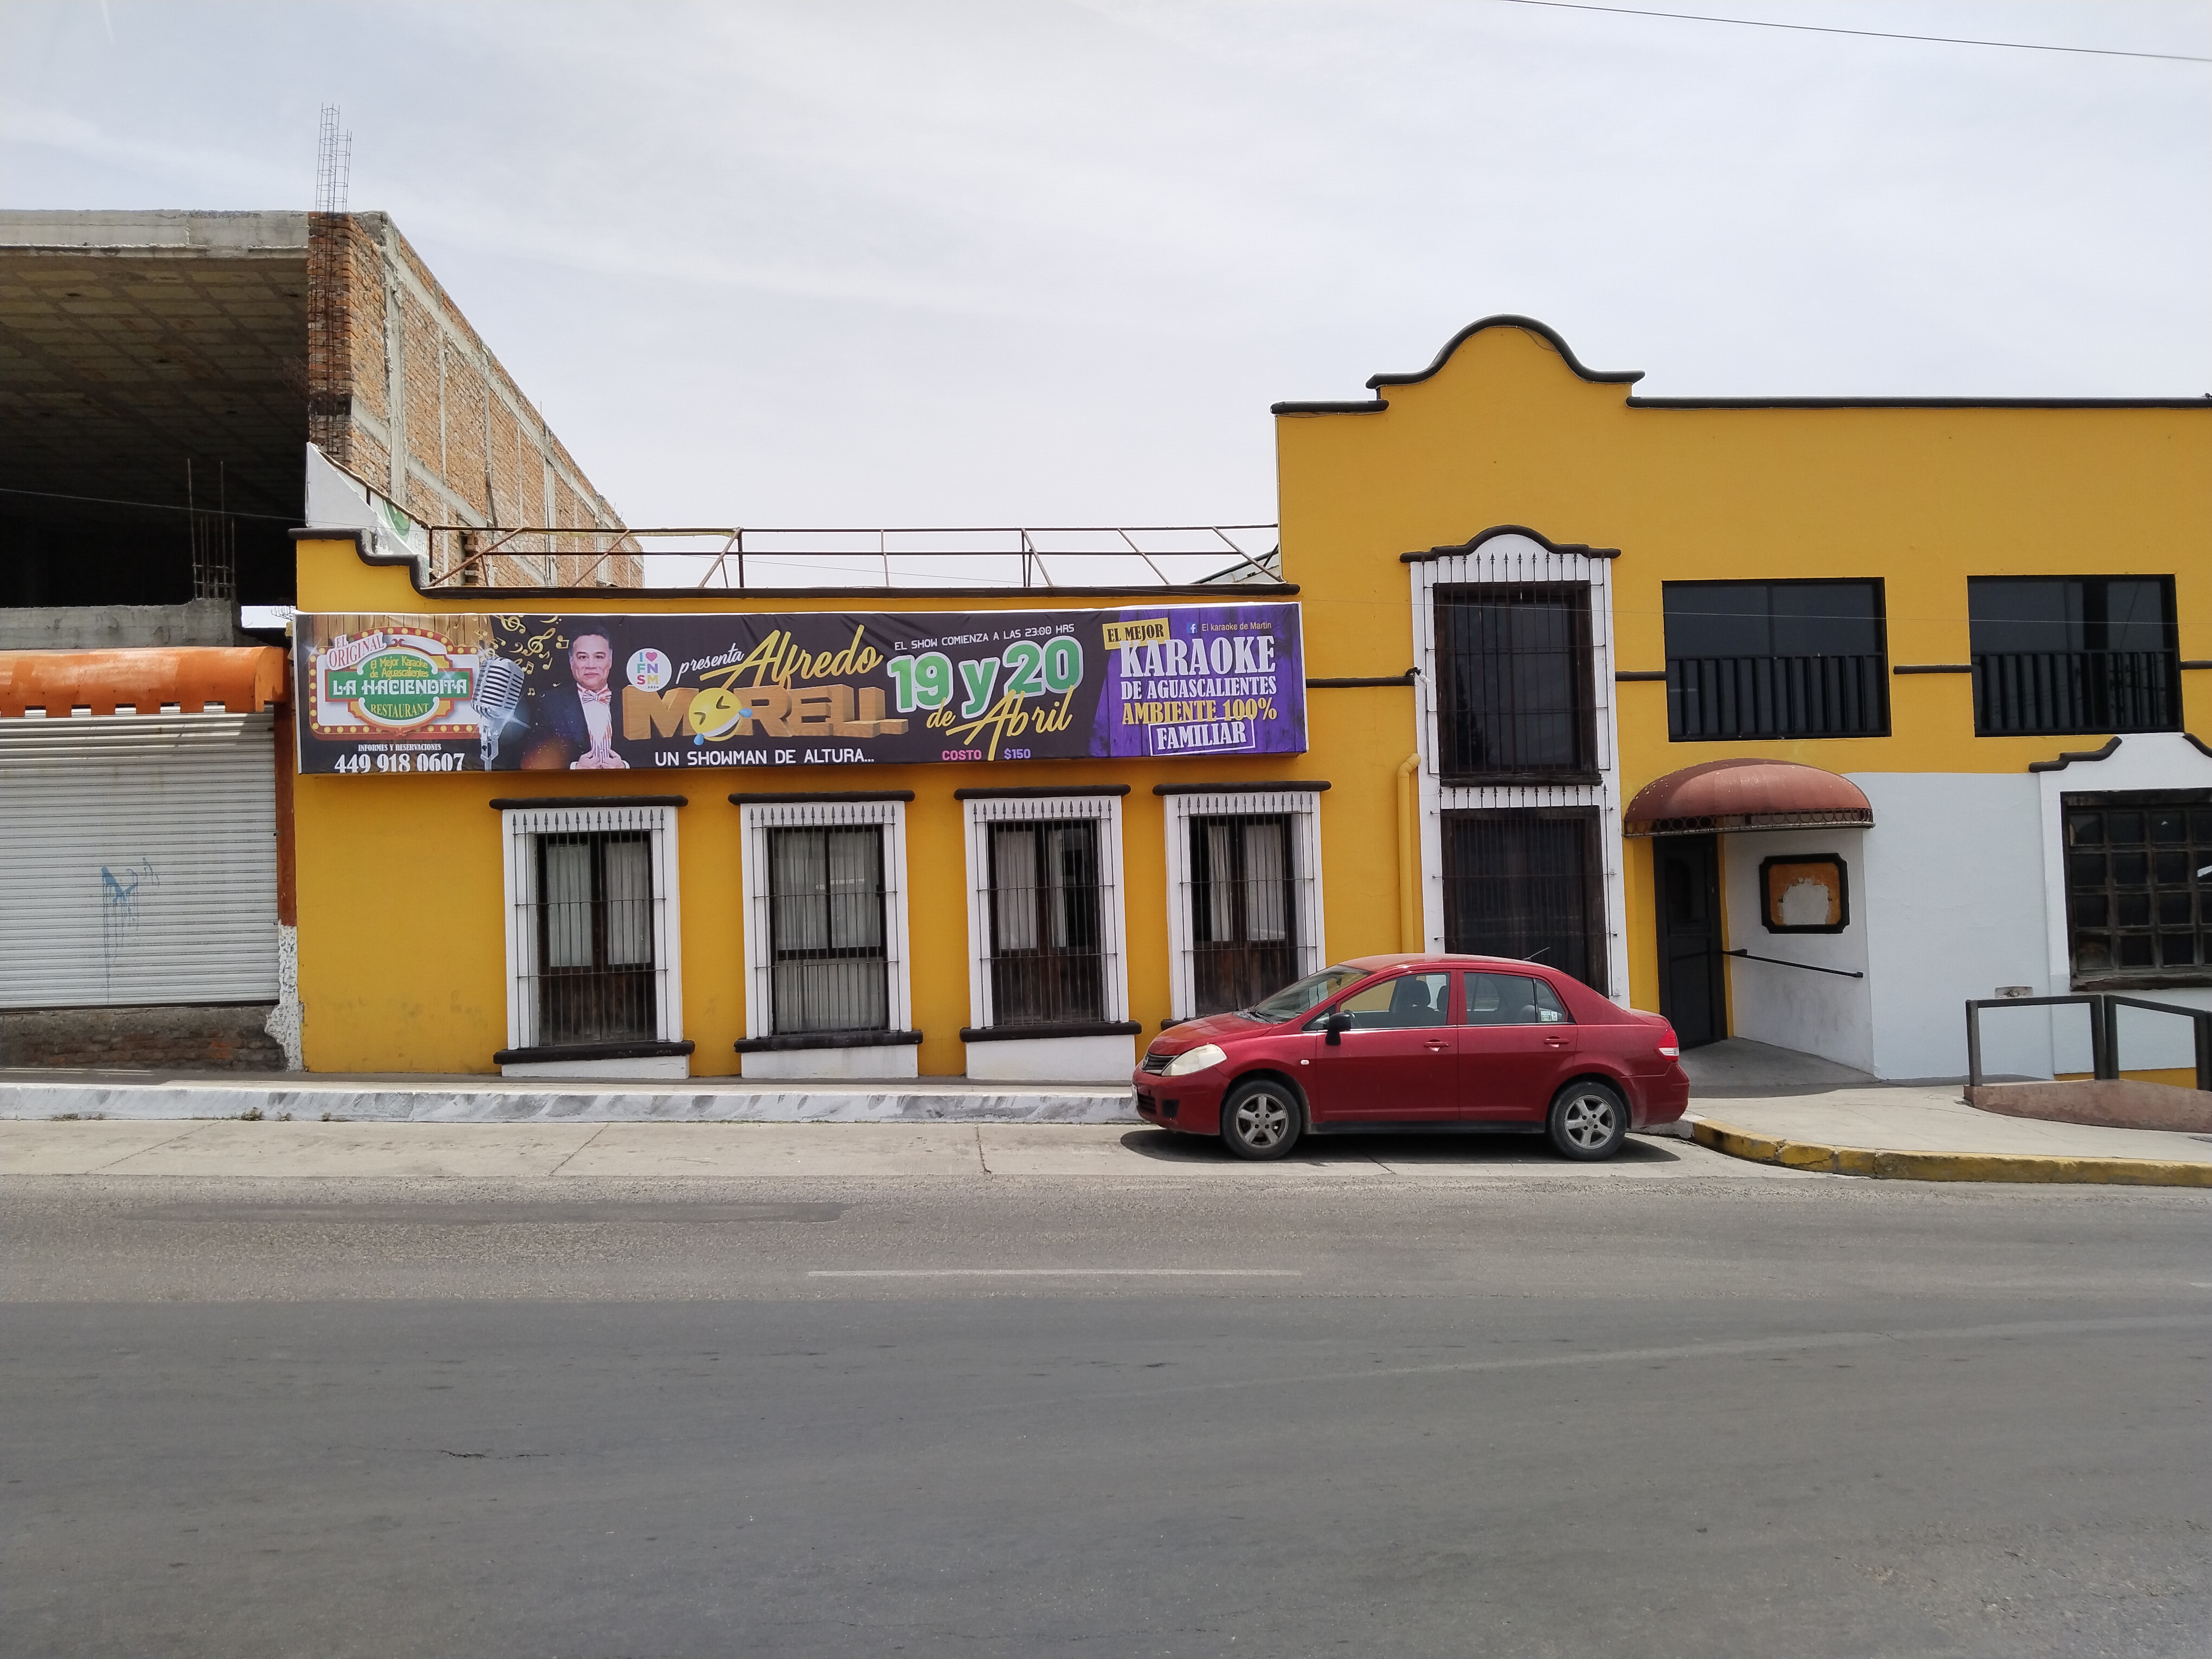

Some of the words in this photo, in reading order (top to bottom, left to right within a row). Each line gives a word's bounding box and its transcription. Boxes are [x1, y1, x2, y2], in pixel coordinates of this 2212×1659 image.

[895, 641, 907, 651] EL
[911, 639, 938, 649] SHOW
[942, 633, 989, 646] COMIENZA
[993, 632, 999, 641] A
[1004, 629, 1021, 640] LAS
[1025, 626, 1051, 637] 23:00
[1056, 623, 1075, 634] HRS
[1107, 628, 1122, 642] EL
[1125, 624, 1164, 642] MEJOR
[1211, 622, 1238, 631] karaoke
[1239, 622, 1249, 630] de
[329, 635, 384, 668] ORIGINAL
[336, 636, 348, 648] EL
[370, 660, 377, 669] El
[380, 656, 399, 670] Mejor
[402, 655, 428, 668] Karaoke
[676, 642, 745, 684] presenta
[699, 624, 884, 690] Alfredo
[1119, 635, 1276, 677] KARAOKE
[370, 669, 378, 678] de
[381, 667, 429, 680] Aguascalientes
[887, 652, 953, 712] 19
[959, 657, 1000, 719] y
[1002, 636, 1084, 699] 20
[333, 680, 357, 695] LA
[361, 679, 467, 696] HACIENDITA
[1121, 681, 1142, 699] DE
[1147, 676, 1277, 699] AGUASCALIENTES
[371, 703, 429, 718] RESTAURANT
[1122, 699, 1217, 724] AMBIENTE
[1223, 697, 1277, 721] 100%
[926, 697, 956, 729] de
[946, 685, 1075, 761] Abril
[1156, 721, 1246, 750] FAMILIAR
[334, 754, 371, 773] 449
[377, 753, 411, 773] 918
[416, 753, 465, 771] 0607
[655, 751, 679, 766] UN
[687, 750, 767, 766] SHOWMAN
[775, 749, 796, 764] DE
[803, 748, 874, 764] ALTURA...
[942, 749, 982, 761] COSTO
[1004, 748, 1031, 760] $150
